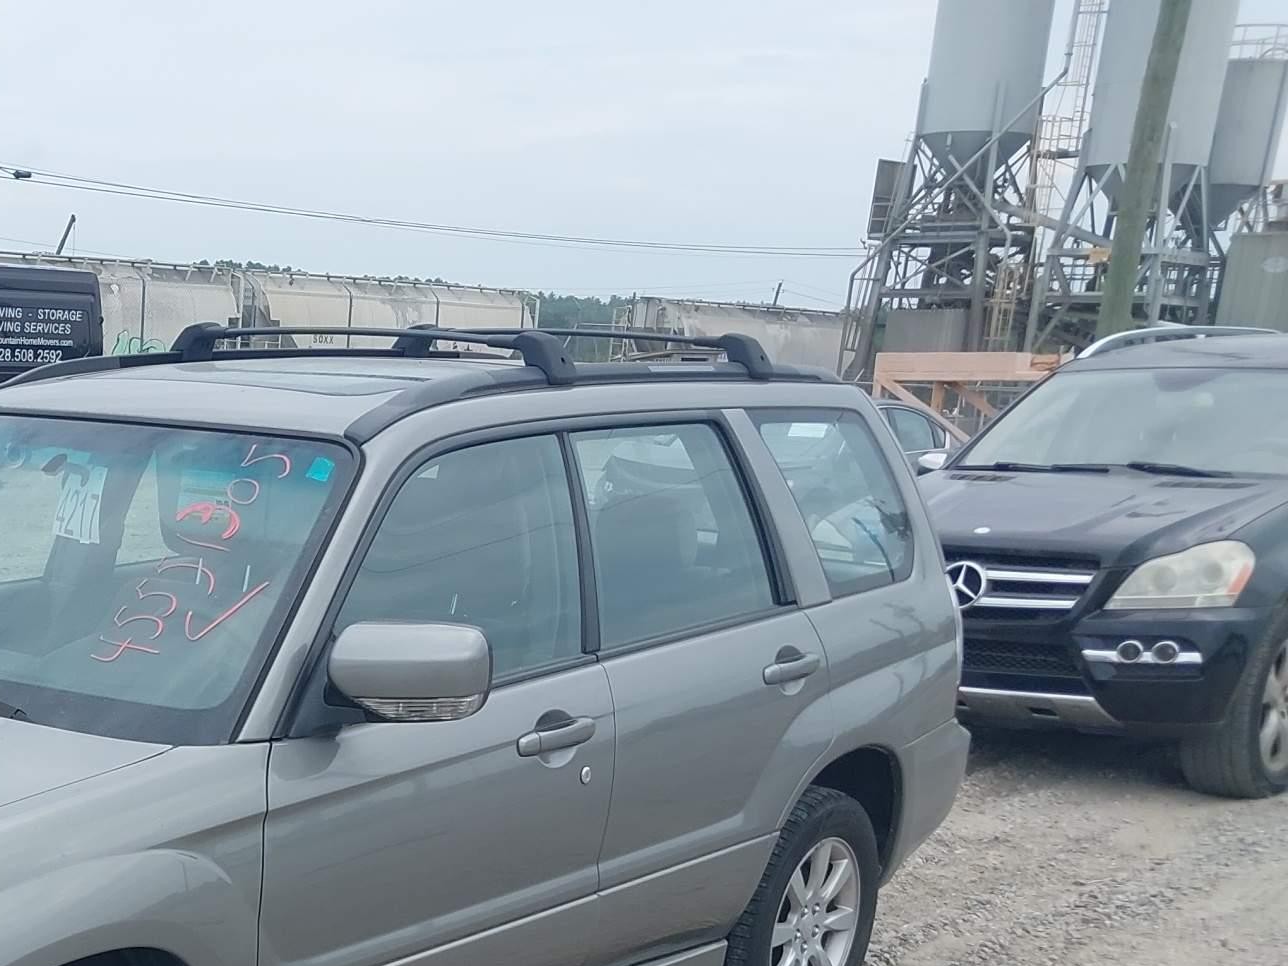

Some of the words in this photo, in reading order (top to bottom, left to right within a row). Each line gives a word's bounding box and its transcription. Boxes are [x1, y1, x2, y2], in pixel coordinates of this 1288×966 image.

[37, 309, 83, 321] STORAGE
[23, 322, 72, 334] SERVICES
[313, 334, 333, 344] SOXX
